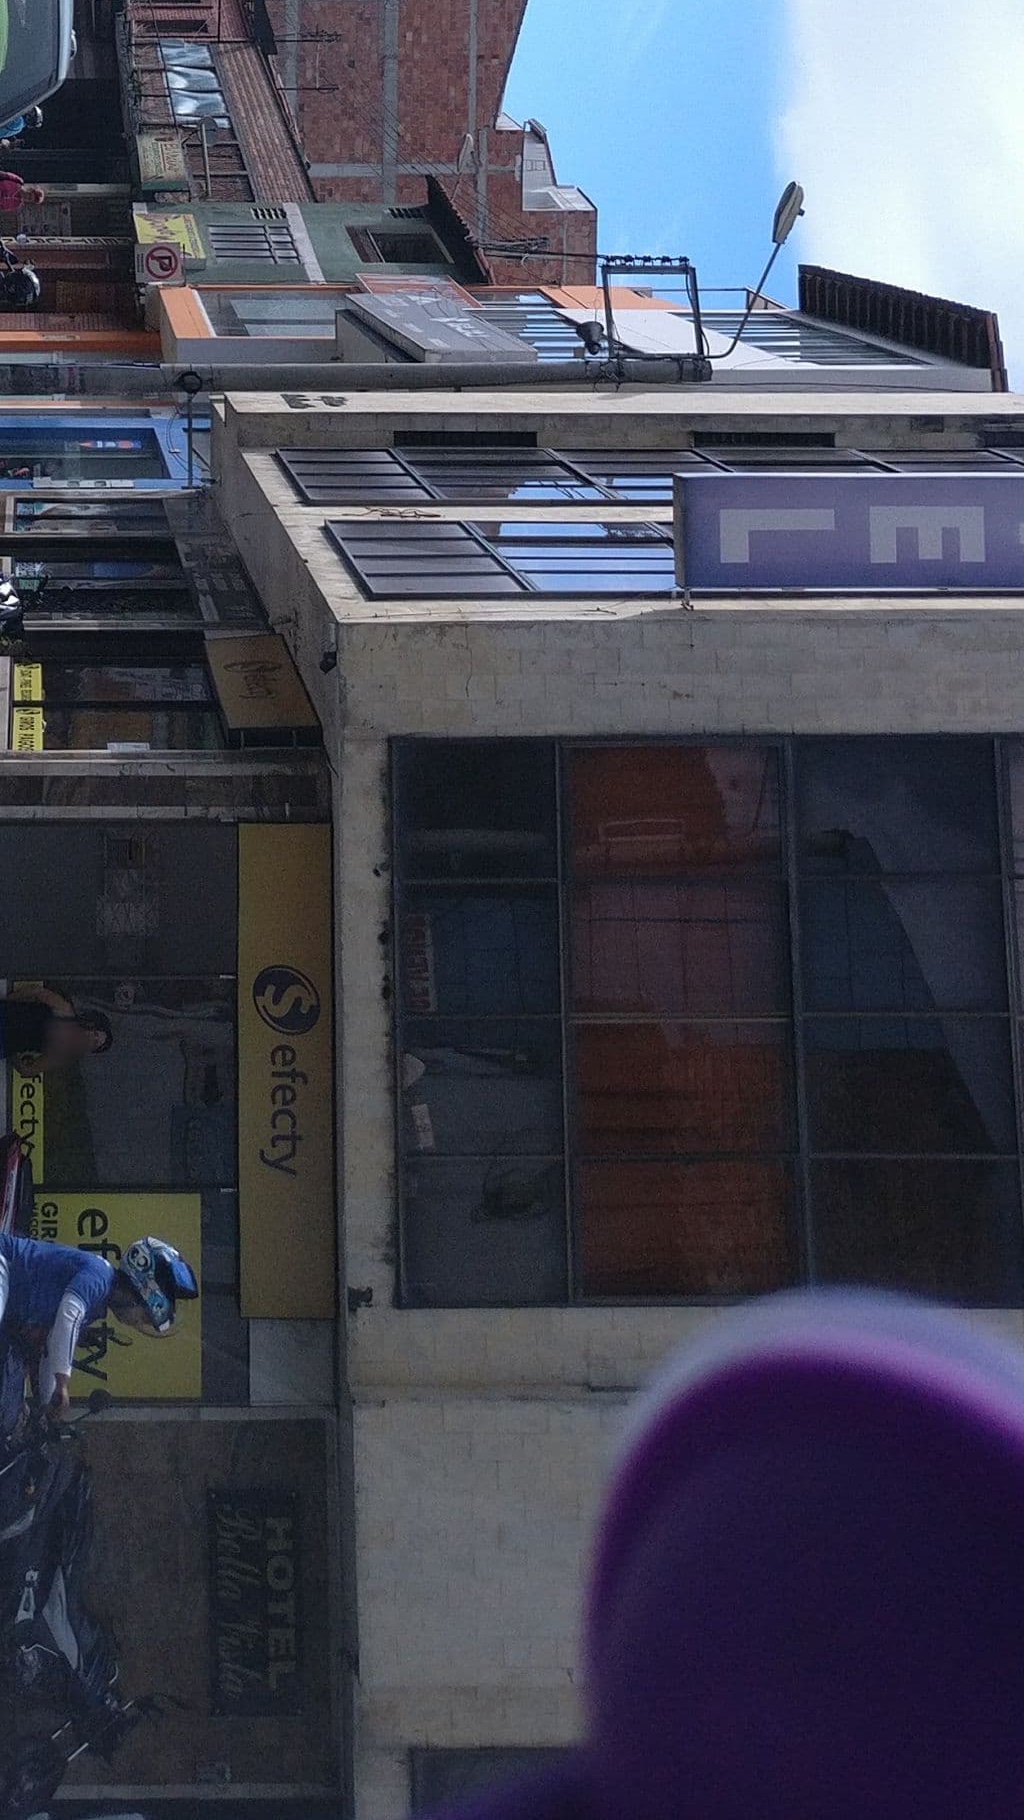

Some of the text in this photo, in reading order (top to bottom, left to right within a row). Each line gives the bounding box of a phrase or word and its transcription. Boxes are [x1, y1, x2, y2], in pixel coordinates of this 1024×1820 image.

[719, 506, 1024, 563] EL
[259, 1043, 308, 1178] efecty
[266, 1516, 297, 1690] HOTEL
